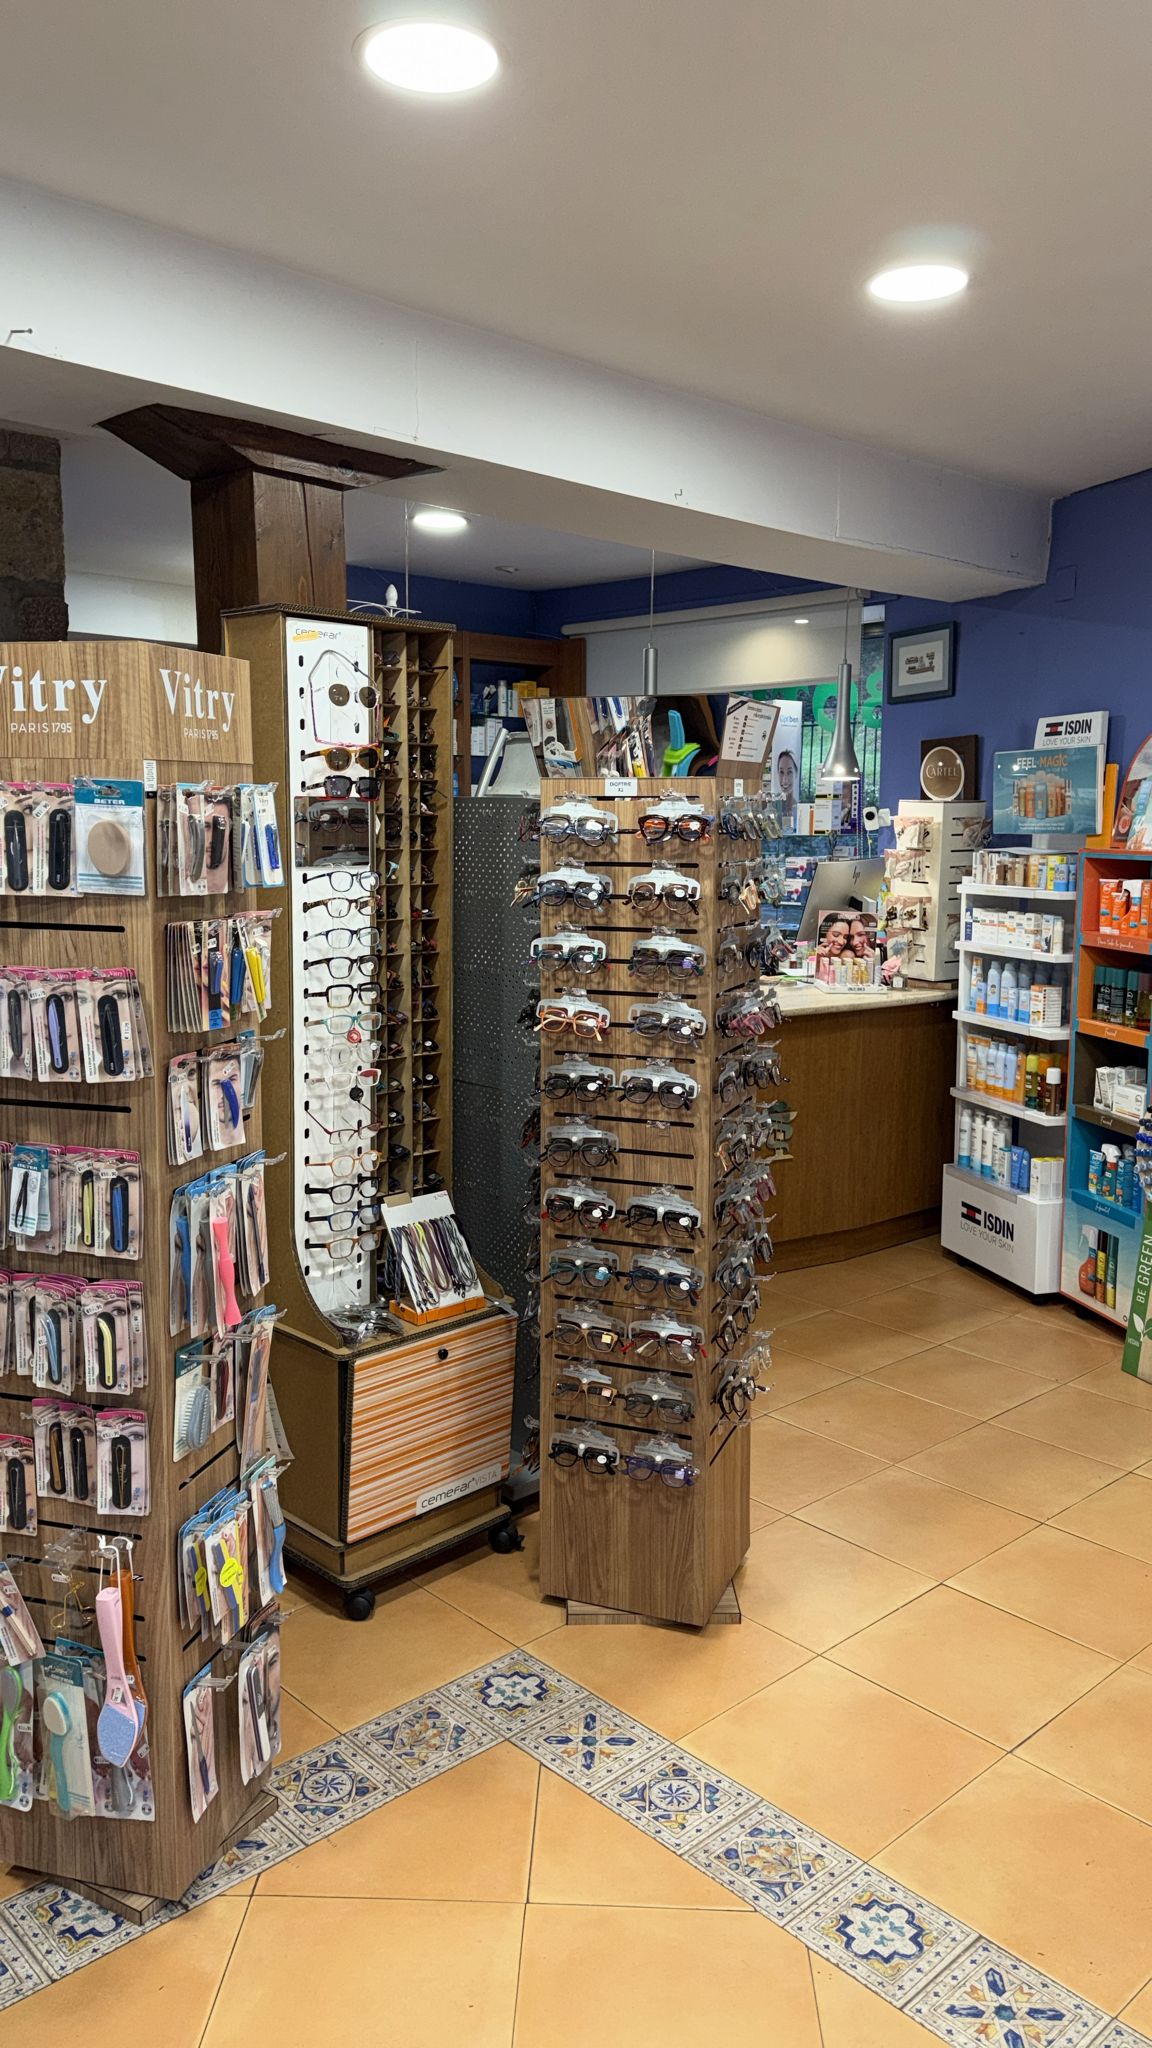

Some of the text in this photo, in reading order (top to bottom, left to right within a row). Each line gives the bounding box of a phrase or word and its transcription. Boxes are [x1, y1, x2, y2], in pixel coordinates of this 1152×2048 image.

[159, 668, 235, 733] Vitry
[10, 722, 73, 734] PARIS 1795
[183, 727, 219, 741] PARIS 1795
[1064, 718, 1093, 736] ISDIN
[1042, 734, 1091, 747] LOVE YOUR SKIN
[1016, 753, 1069, 769] FEEL MAGIC
[925, 764, 959, 779] CARTEL
[983, 1210, 1015, 1242] ISDIN
[960, 1221, 1015, 1254] LOVE YOUR SKIN
[1136, 1234, 1152, 1304] BE GREEN
